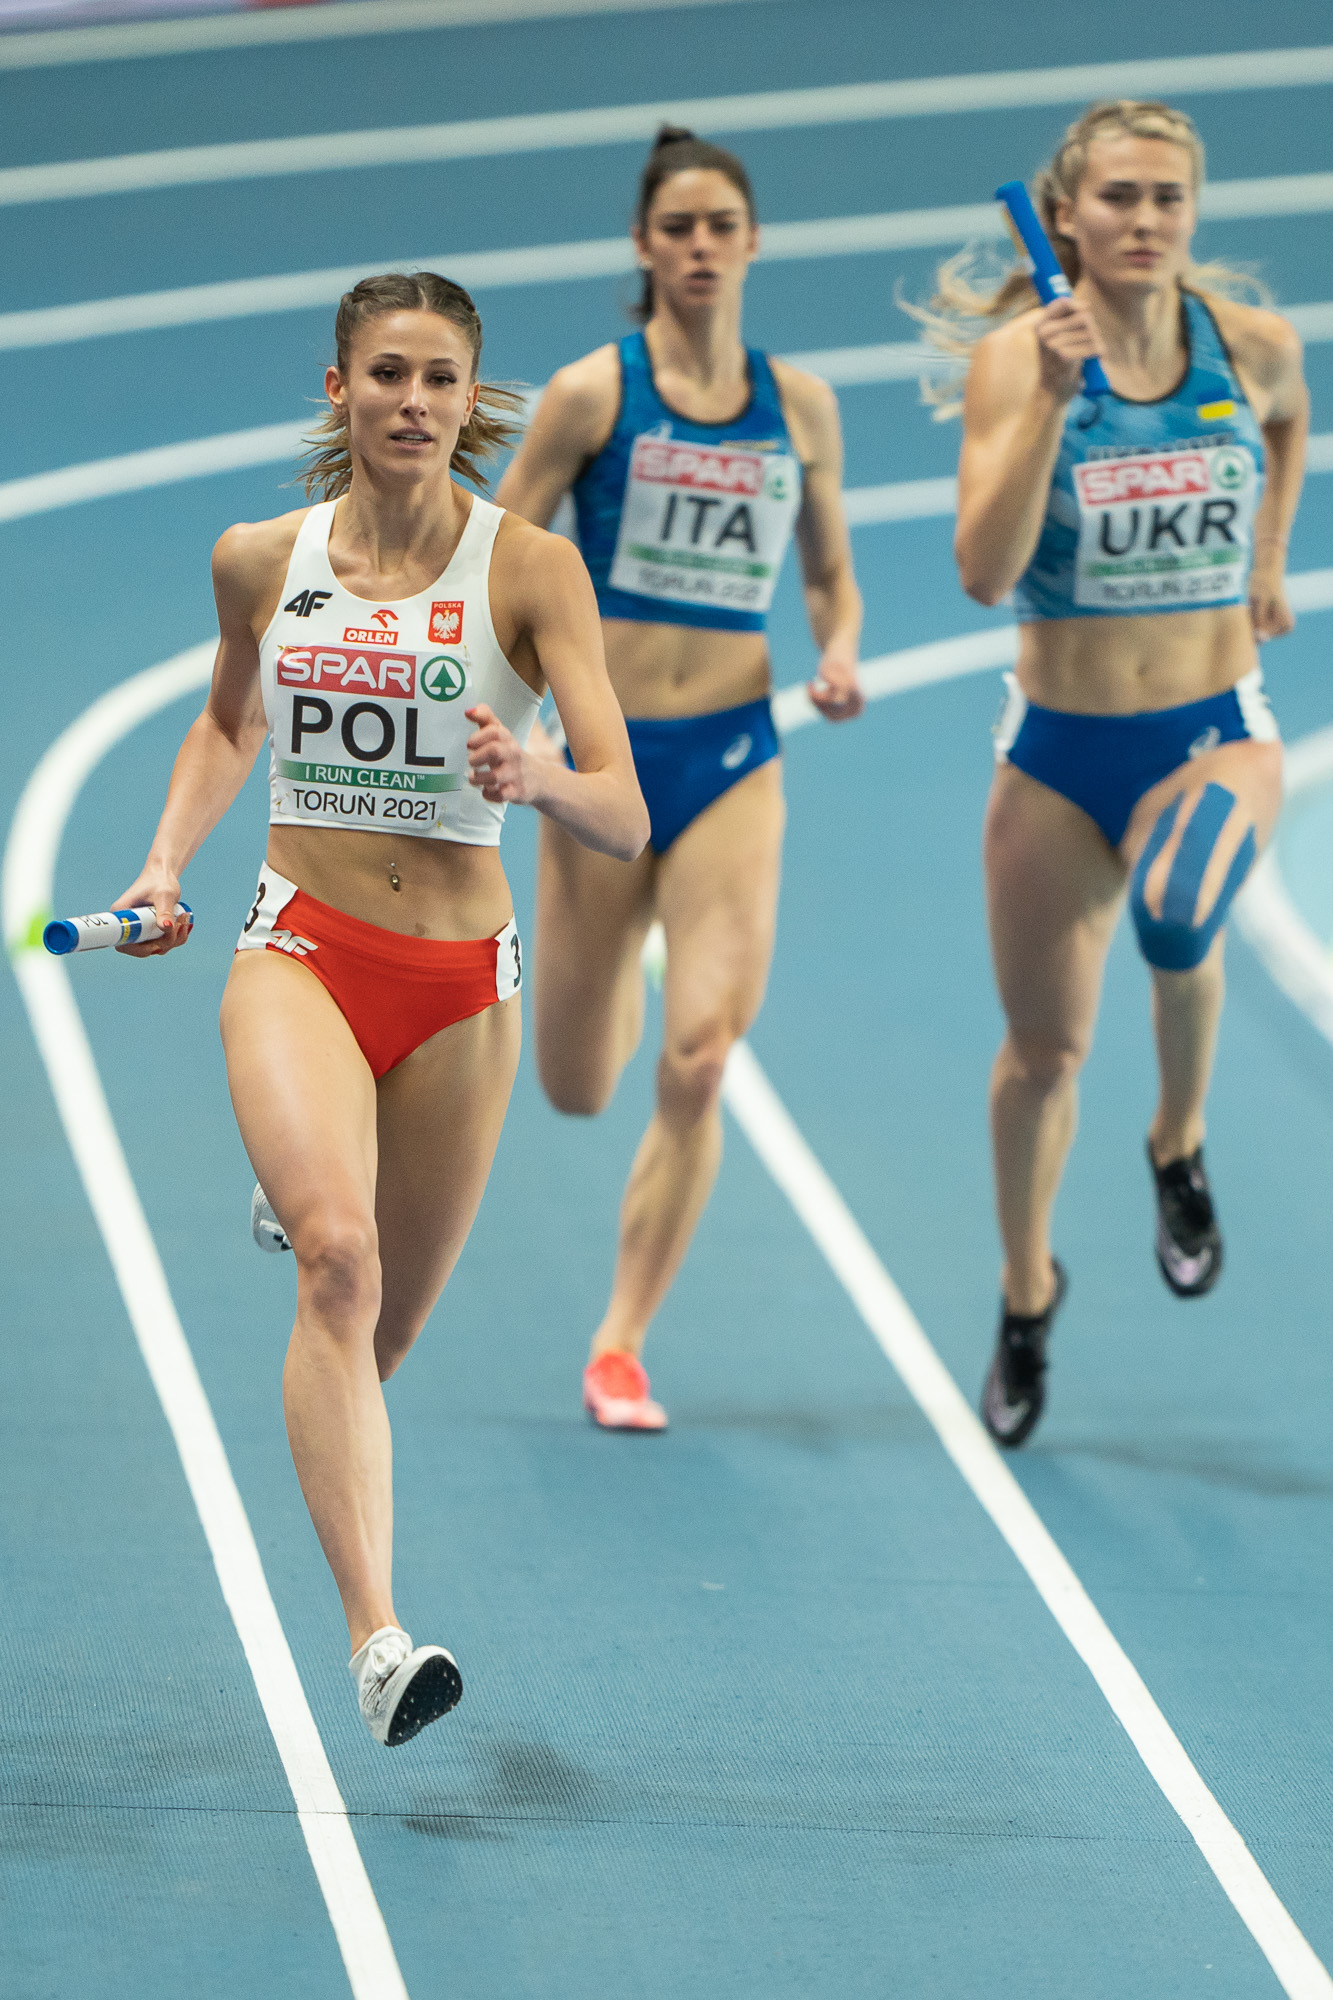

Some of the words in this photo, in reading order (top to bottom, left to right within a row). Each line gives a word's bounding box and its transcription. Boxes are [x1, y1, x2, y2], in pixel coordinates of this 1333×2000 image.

[638, 445, 760, 489] SPAR
[1083, 464, 1208, 501] SPAR
[660, 492, 757, 554] ITA
[1098, 498, 1238, 557] UKR
[284, 589, 333, 617] 4F
[346, 629, 395, 644] ORLEN
[280, 651, 413, 692] SPAR
[290, 695, 445, 767] POL
[315, 767, 352, 782] RUN
[293, 789, 376, 816] TORUŃ
[383, 798, 437, 820] 2021
